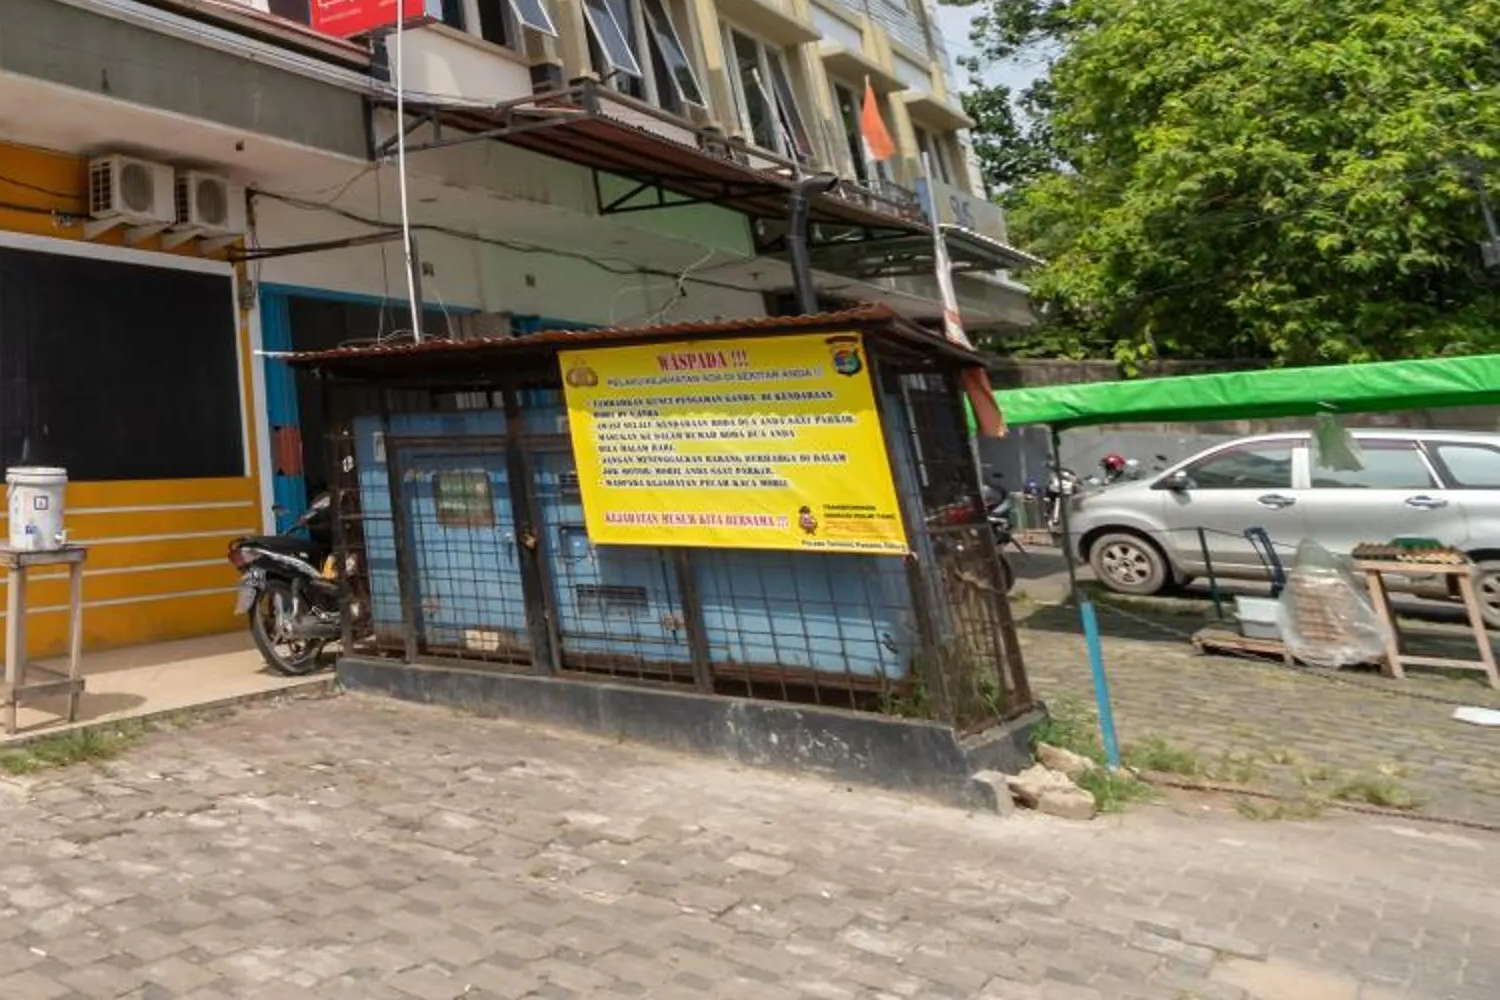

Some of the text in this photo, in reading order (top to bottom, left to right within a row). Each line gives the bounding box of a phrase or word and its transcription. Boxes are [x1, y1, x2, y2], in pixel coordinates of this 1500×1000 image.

[657, 351, 727, 371] WASPADA
[605, 512, 659, 523] KEJAHATAN
[661, 512, 697, 525] MUSUH
[699, 513, 723, 525] KITA
[725, 515, 775, 527] BERSAMA
